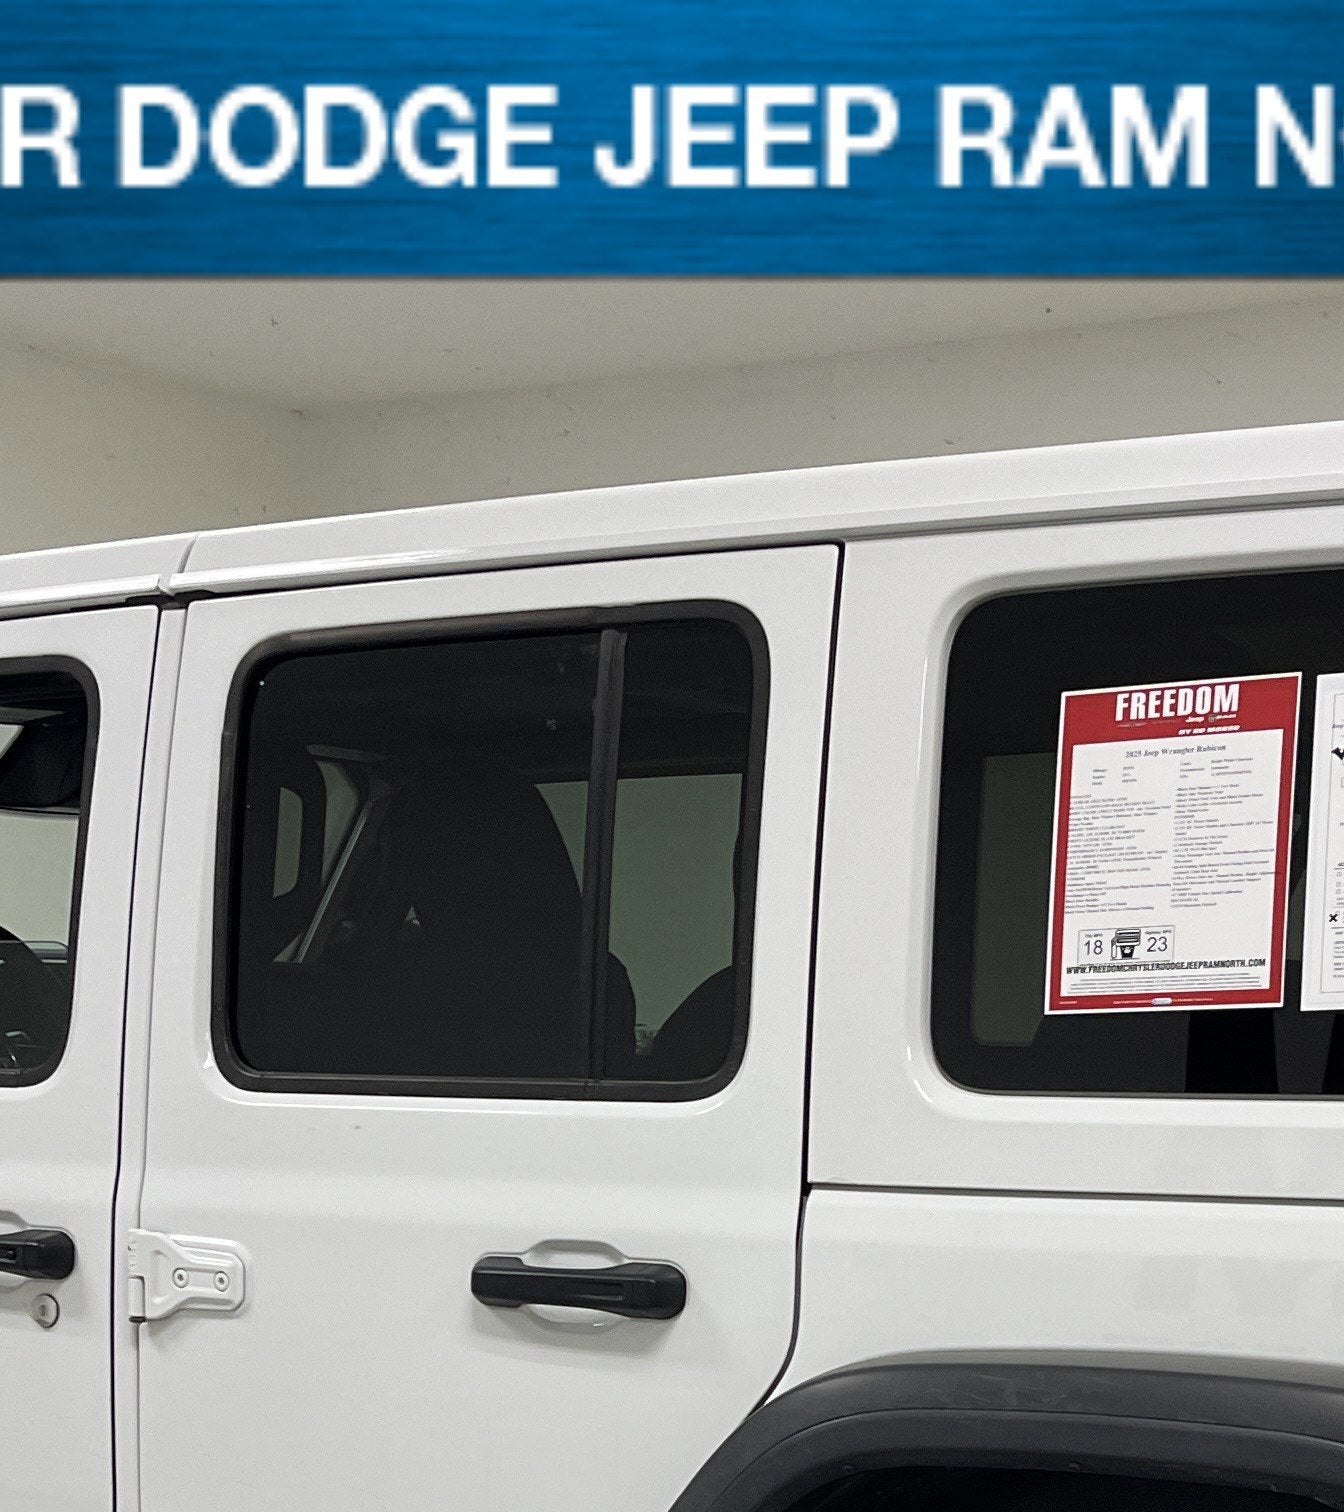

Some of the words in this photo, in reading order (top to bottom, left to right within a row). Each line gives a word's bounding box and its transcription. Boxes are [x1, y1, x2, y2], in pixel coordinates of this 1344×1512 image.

[1115, 684, 1240, 722] FREEDOM
[1084, 940, 1103, 956] 18
[1146, 937, 1168, 952] 23
